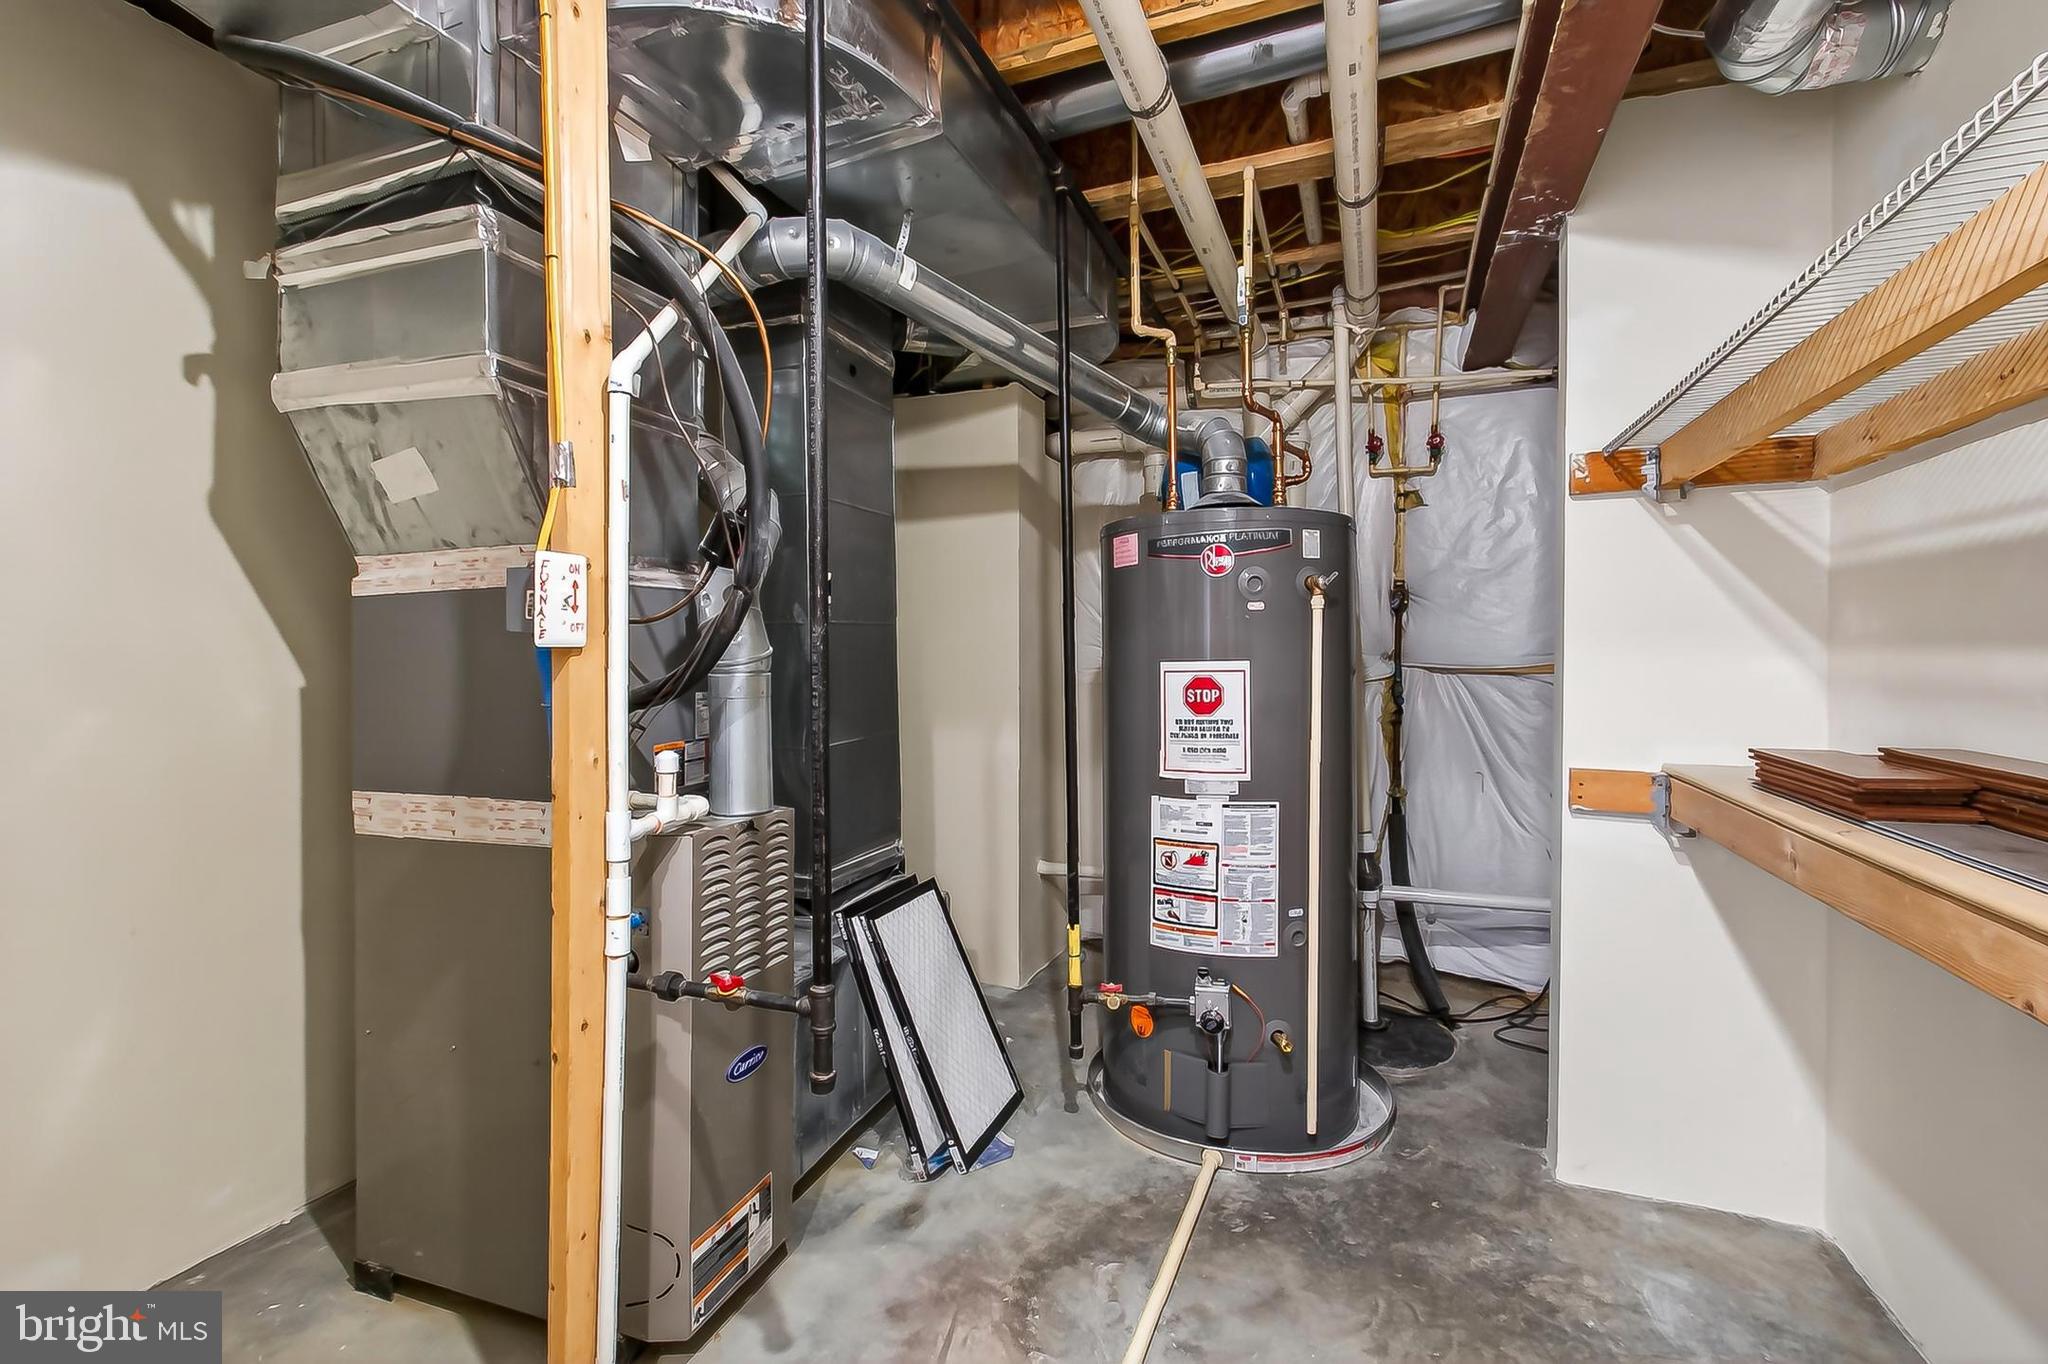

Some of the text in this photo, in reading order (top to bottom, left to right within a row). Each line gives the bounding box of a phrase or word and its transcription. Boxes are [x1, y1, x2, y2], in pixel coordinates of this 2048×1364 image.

[568, 563, 581, 575] ON
[570, 622, 585, 632] OFF
[1187, 689, 1220, 703] STOP
